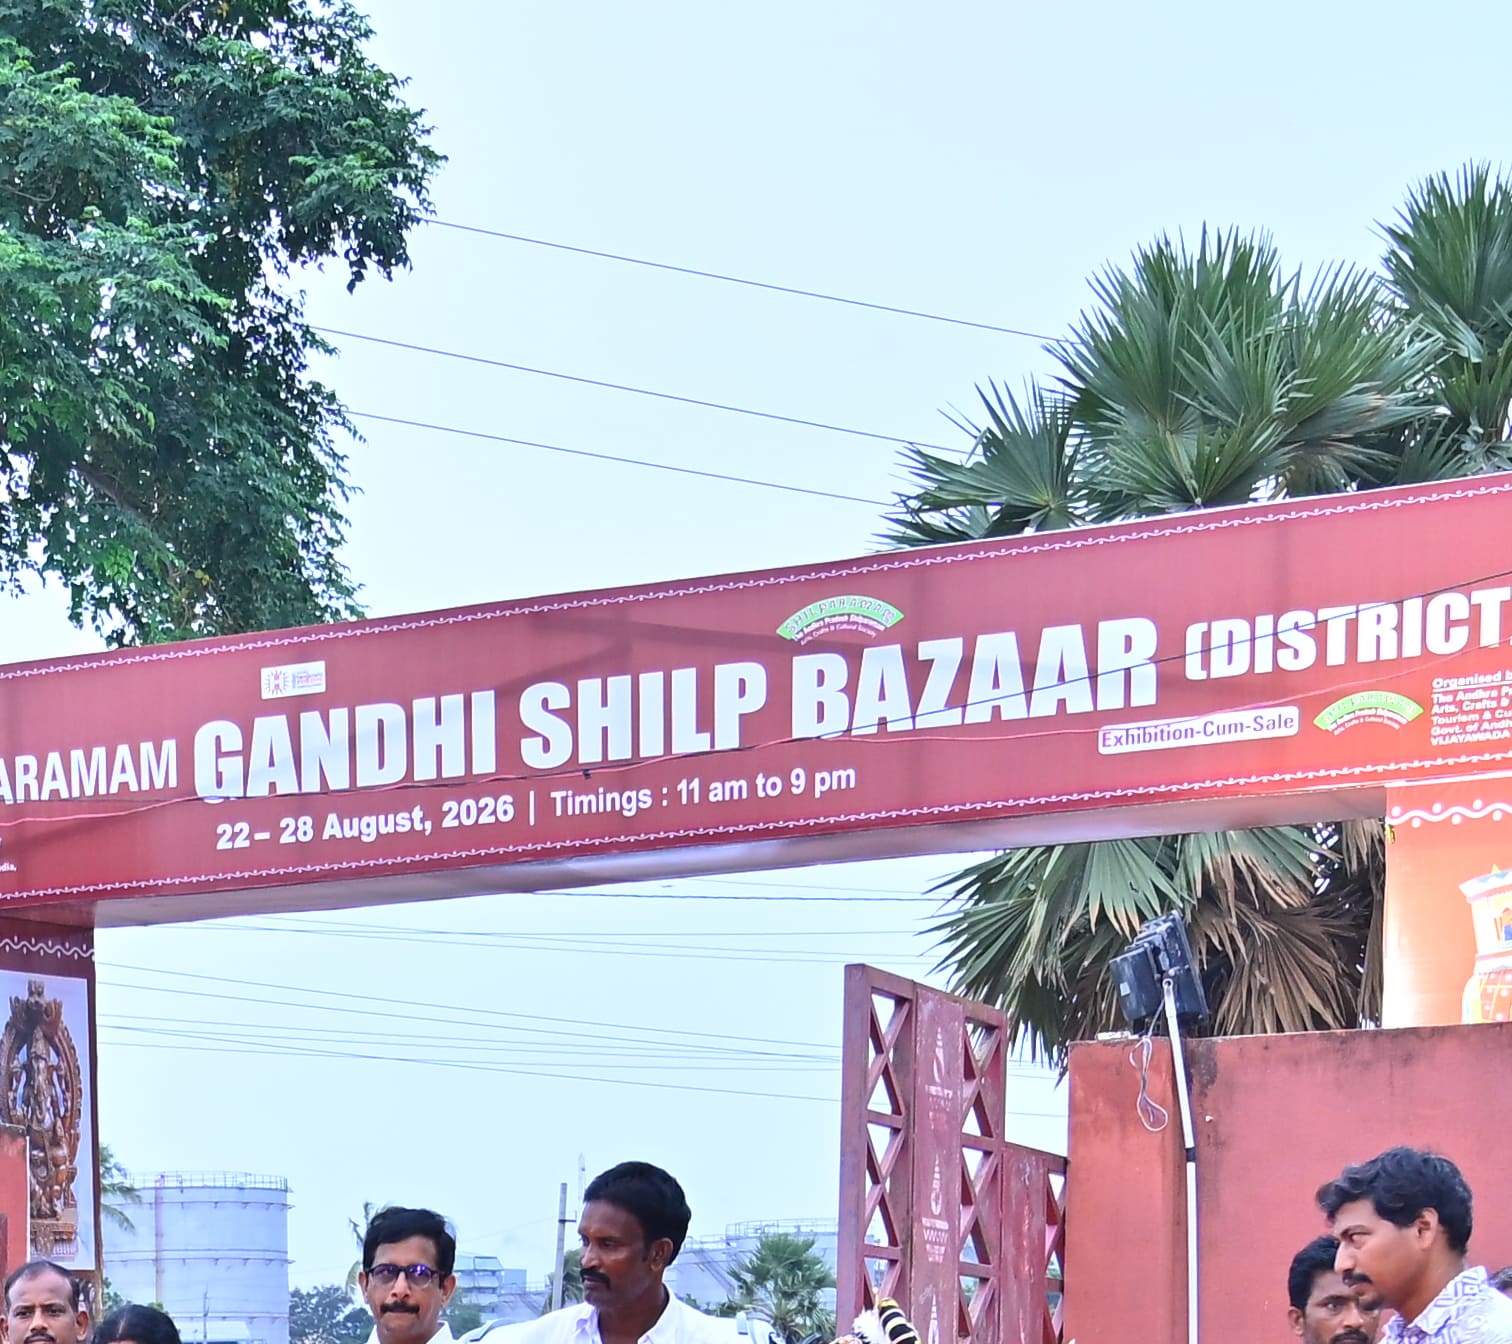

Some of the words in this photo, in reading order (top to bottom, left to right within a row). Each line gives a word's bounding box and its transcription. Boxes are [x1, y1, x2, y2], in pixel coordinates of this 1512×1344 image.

[1432, 672, 1503, 690] Organised
[1432, 692, 1453, 704] The
[1456, 688, 1497, 702] Andhra
[193, 690, 496, 803] GANDHI
[519, 662, 767, 769] SHILP
[791, 617, 1158, 740] BAZAAR
[1431, 703, 1459, 715] Arts,
[1462, 699, 1497, 712] Crafts
[1432, 713, 1479, 726] Tourism
[1101, 713, 1295, 748] Exhibition-Cum-Sale
[1431, 725, 1462, 737] Govt.
[1466, 722, 1479, 734] of
[1431, 730, 1511, 746] VIJAYAWADA
[280, 817, 313, 844] 28
[323, 804, 432, 843] August,
[442, 795, 515, 829] 2026
[550, 785, 652, 818] Timings
[677, 777, 700, 804] 11
[709, 780, 747, 802] am
[756, 773, 782, 798] to
[790, 767, 807, 794] 9
[815, 766, 856, 799] pm
